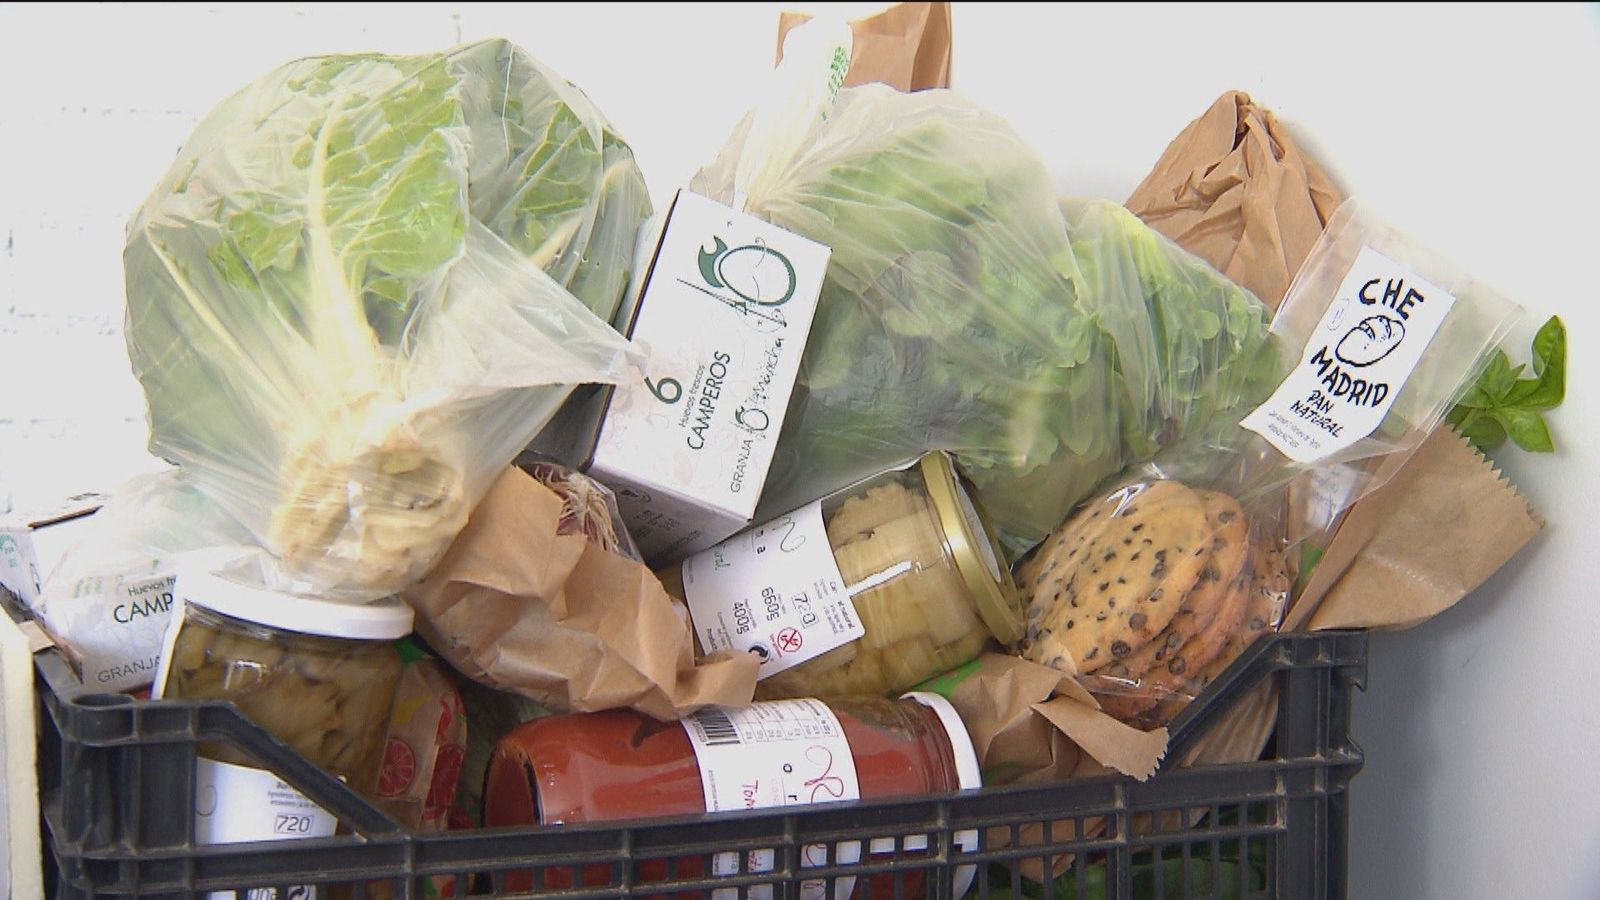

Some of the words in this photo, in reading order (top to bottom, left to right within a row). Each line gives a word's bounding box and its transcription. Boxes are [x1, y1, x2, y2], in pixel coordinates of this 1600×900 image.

[1359, 279, 1424, 320] CHE
[644, 376, 683, 404] 6
[1311, 346, 1388, 407] MADRID
[687, 351, 731, 450] CAMPEROS
[1308, 390, 1335, 414] PAN
[1290, 400, 1344, 438] NATURAL
[731, 439, 754, 493] GRANJA
[127, 580, 165, 597] Huevos
[113, 593, 175, 624] CAMP
[277, 814, 309, 831] 720
